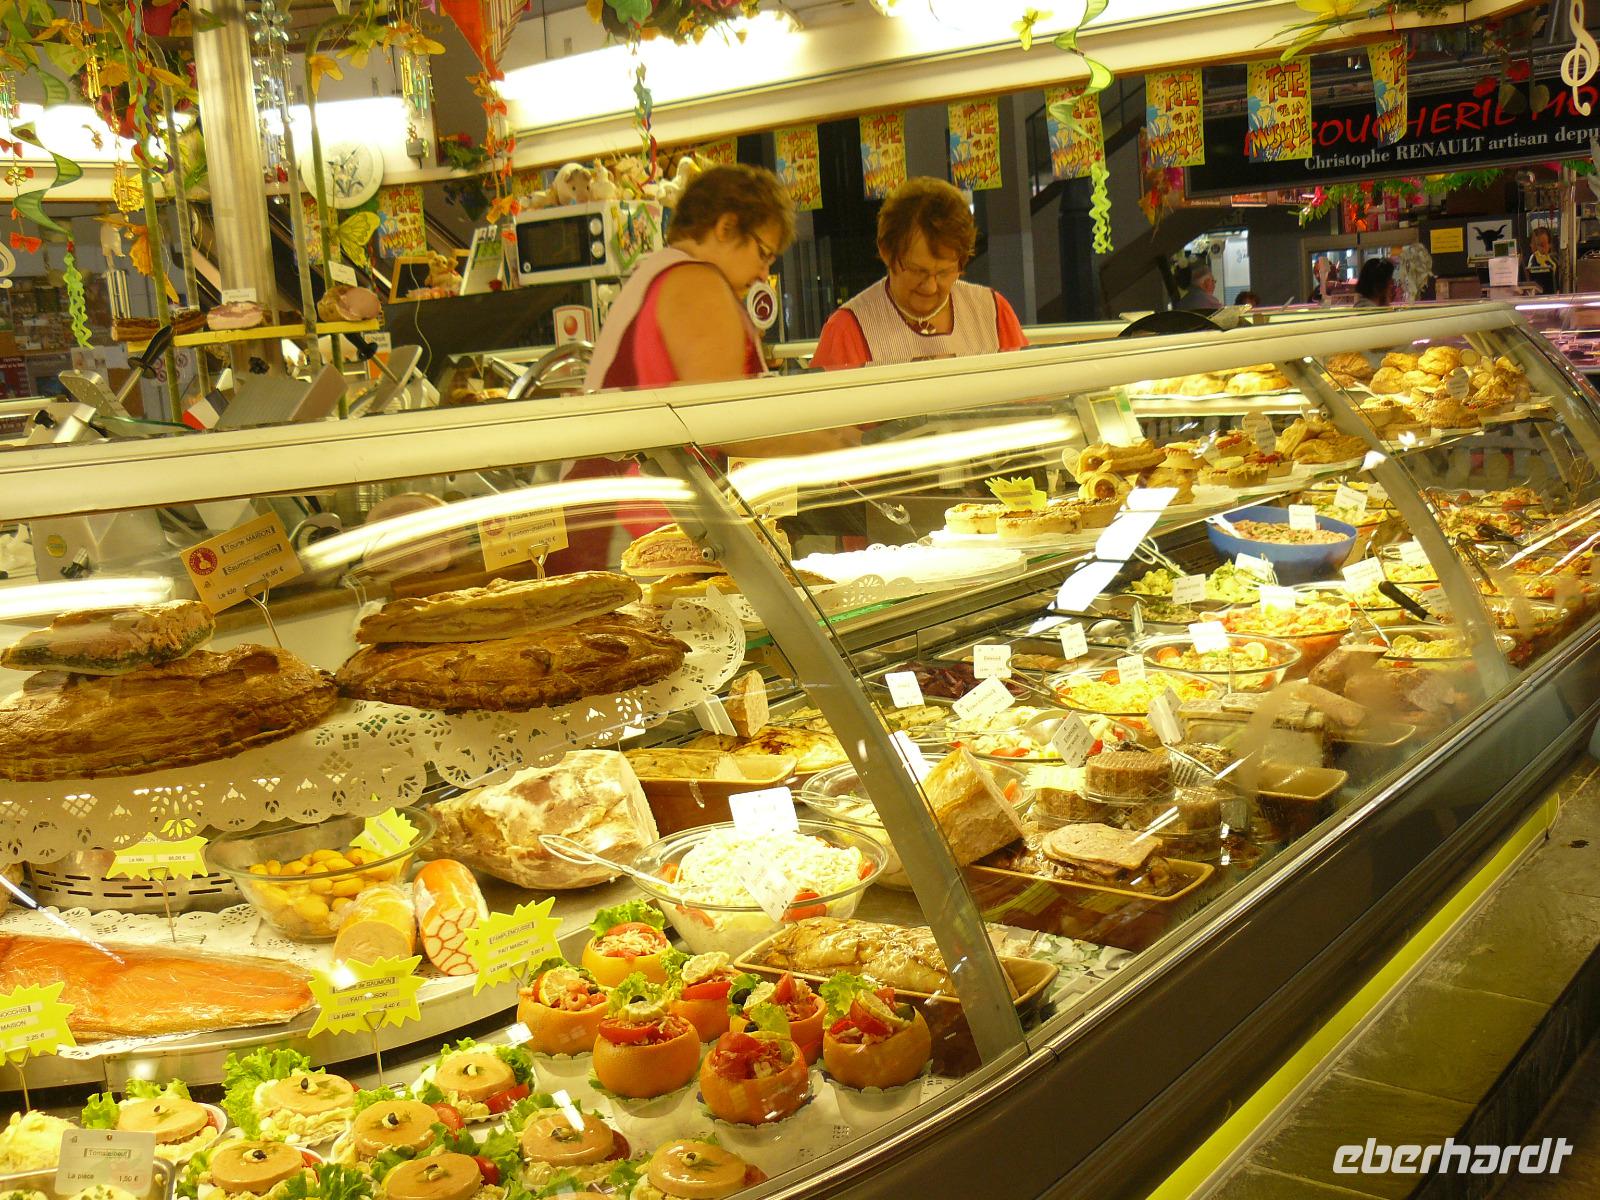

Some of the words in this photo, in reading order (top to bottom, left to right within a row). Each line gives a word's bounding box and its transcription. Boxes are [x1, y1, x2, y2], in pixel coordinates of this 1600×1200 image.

[1243, 96, 1517, 157] OUHERI
[1304, 148, 1390, 171] Christophe
[1396, 136, 1485, 161] RENAULT
[1488, 132, 1548, 150] artisan
